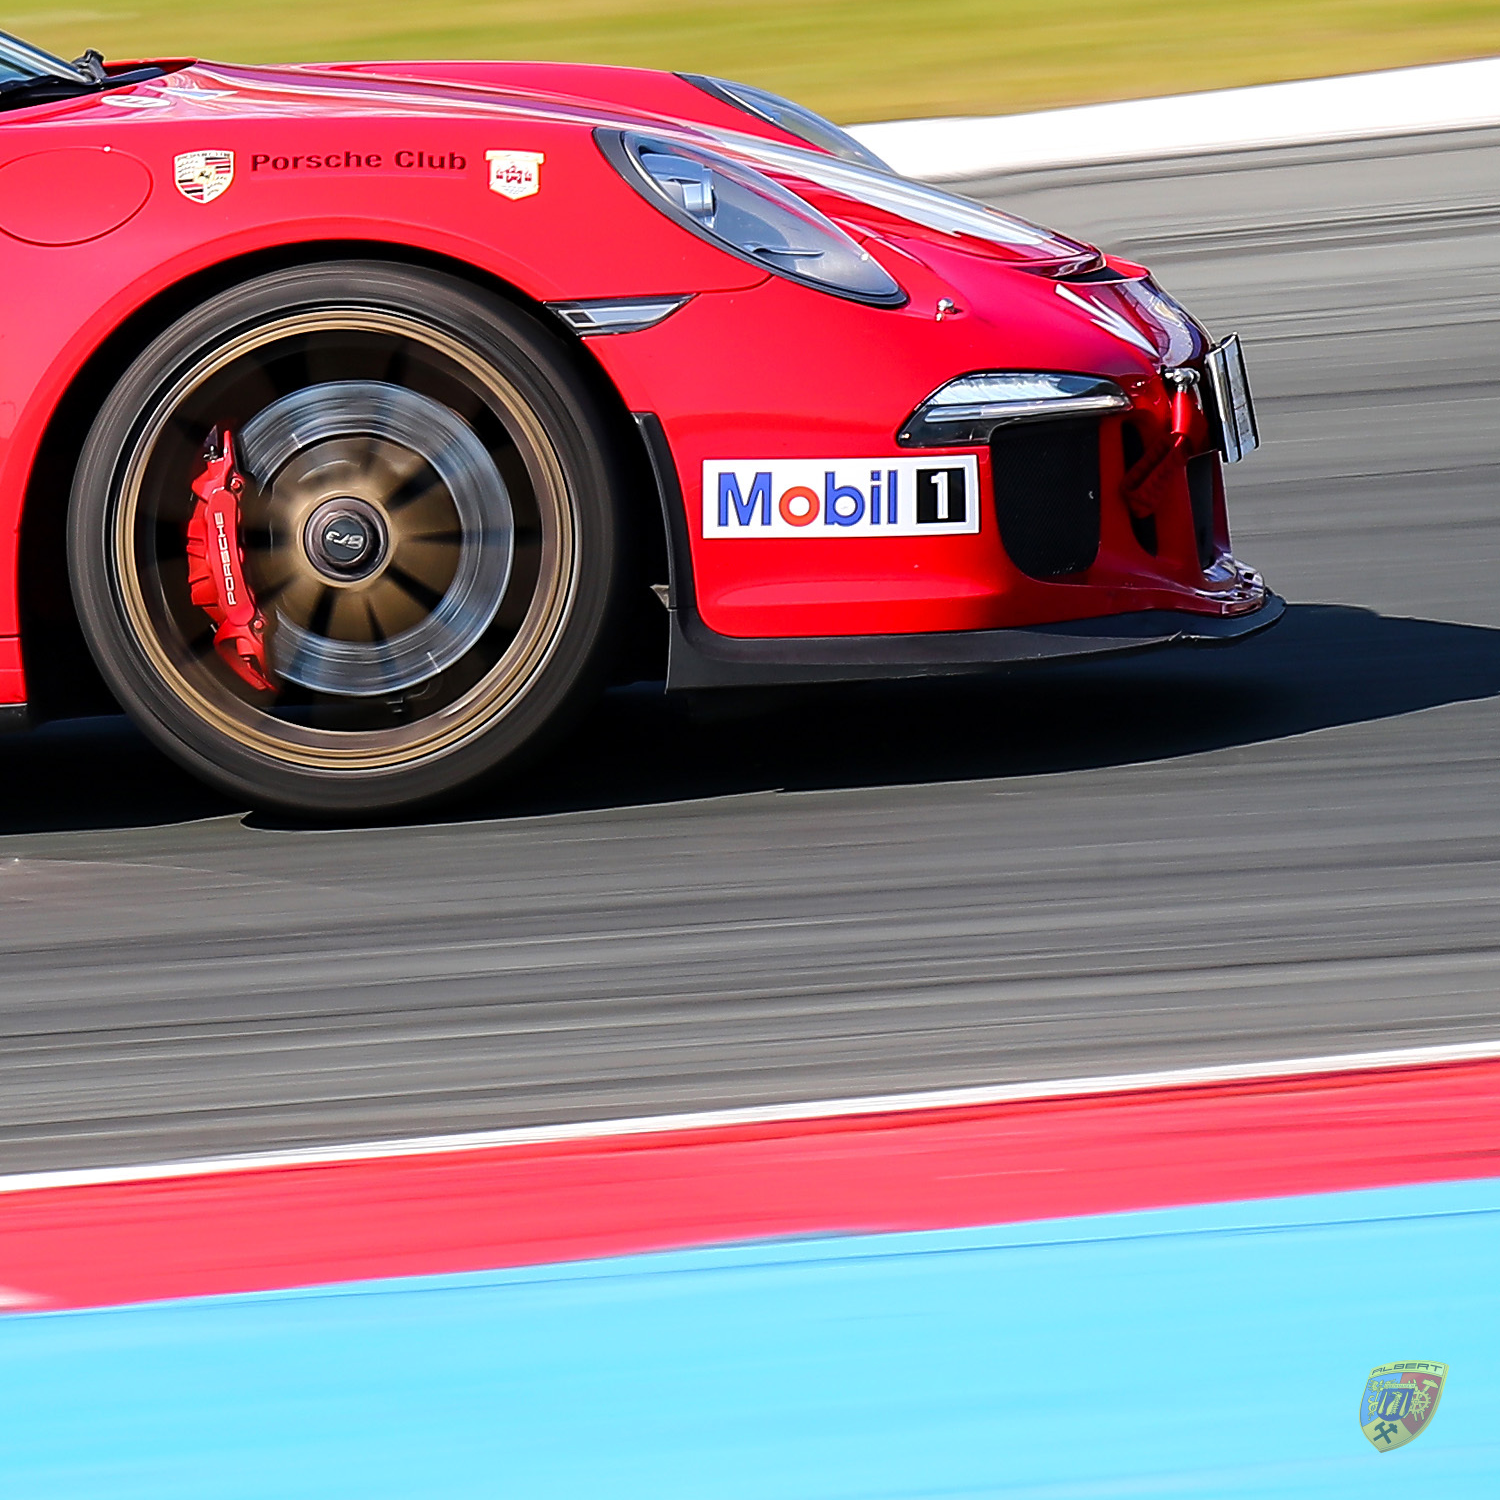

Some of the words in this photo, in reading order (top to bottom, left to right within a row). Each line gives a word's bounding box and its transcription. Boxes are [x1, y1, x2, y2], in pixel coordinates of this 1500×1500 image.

[252, 151, 382, 172] Porsche
[395, 150, 467, 170] Club
[718, 470, 898, 527] Mobil
[930, 472, 949, 520] 1
[214, 512, 236, 605] PORSCHE
